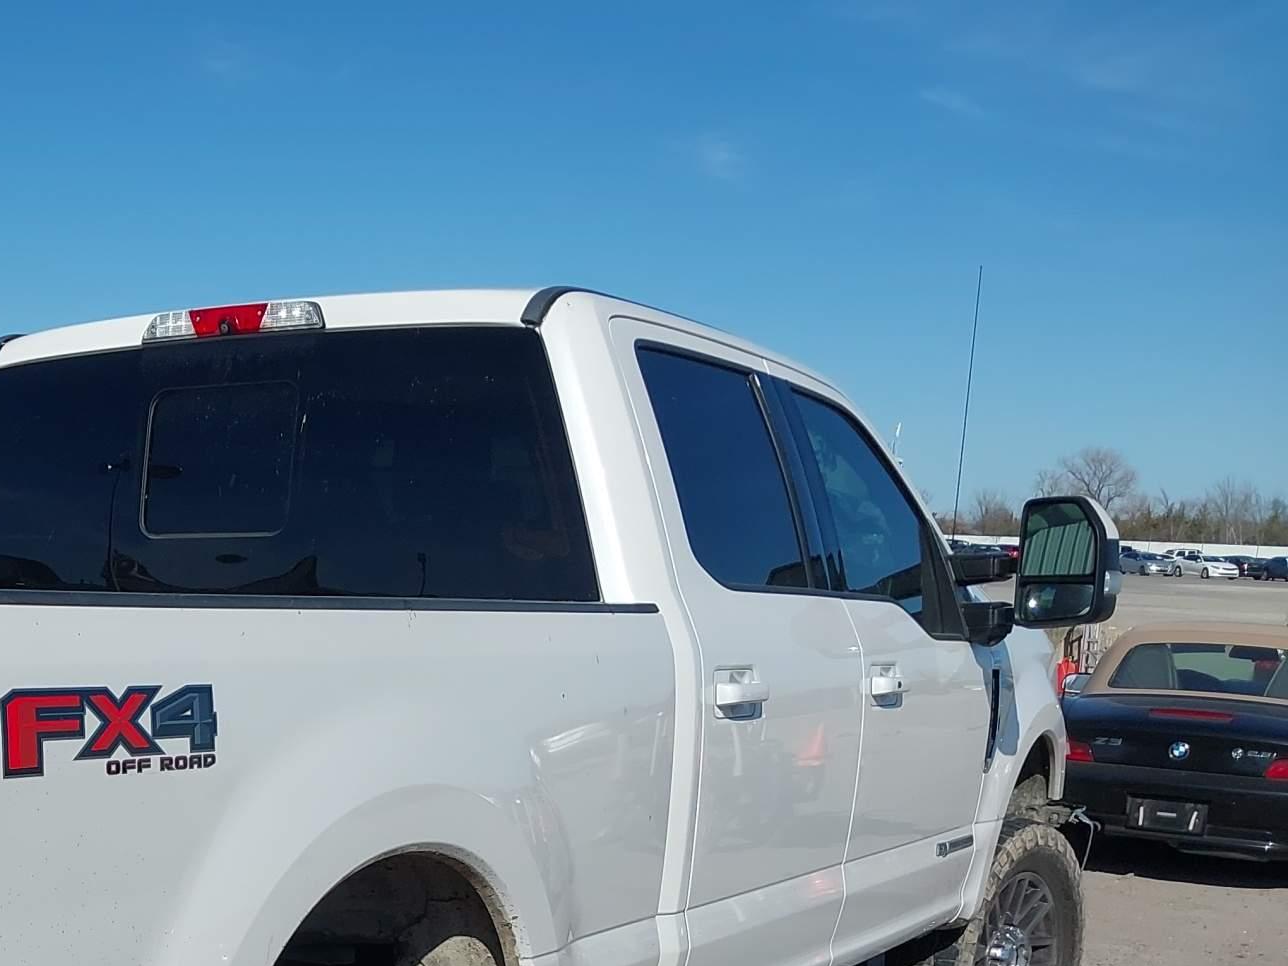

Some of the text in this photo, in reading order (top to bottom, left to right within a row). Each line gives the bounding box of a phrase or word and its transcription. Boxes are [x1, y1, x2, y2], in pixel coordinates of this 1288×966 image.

[0, 684, 217, 779] FX4
[1094, 736, 1123, 746] Z3
[106, 753, 217, 776] OFF ROAD
